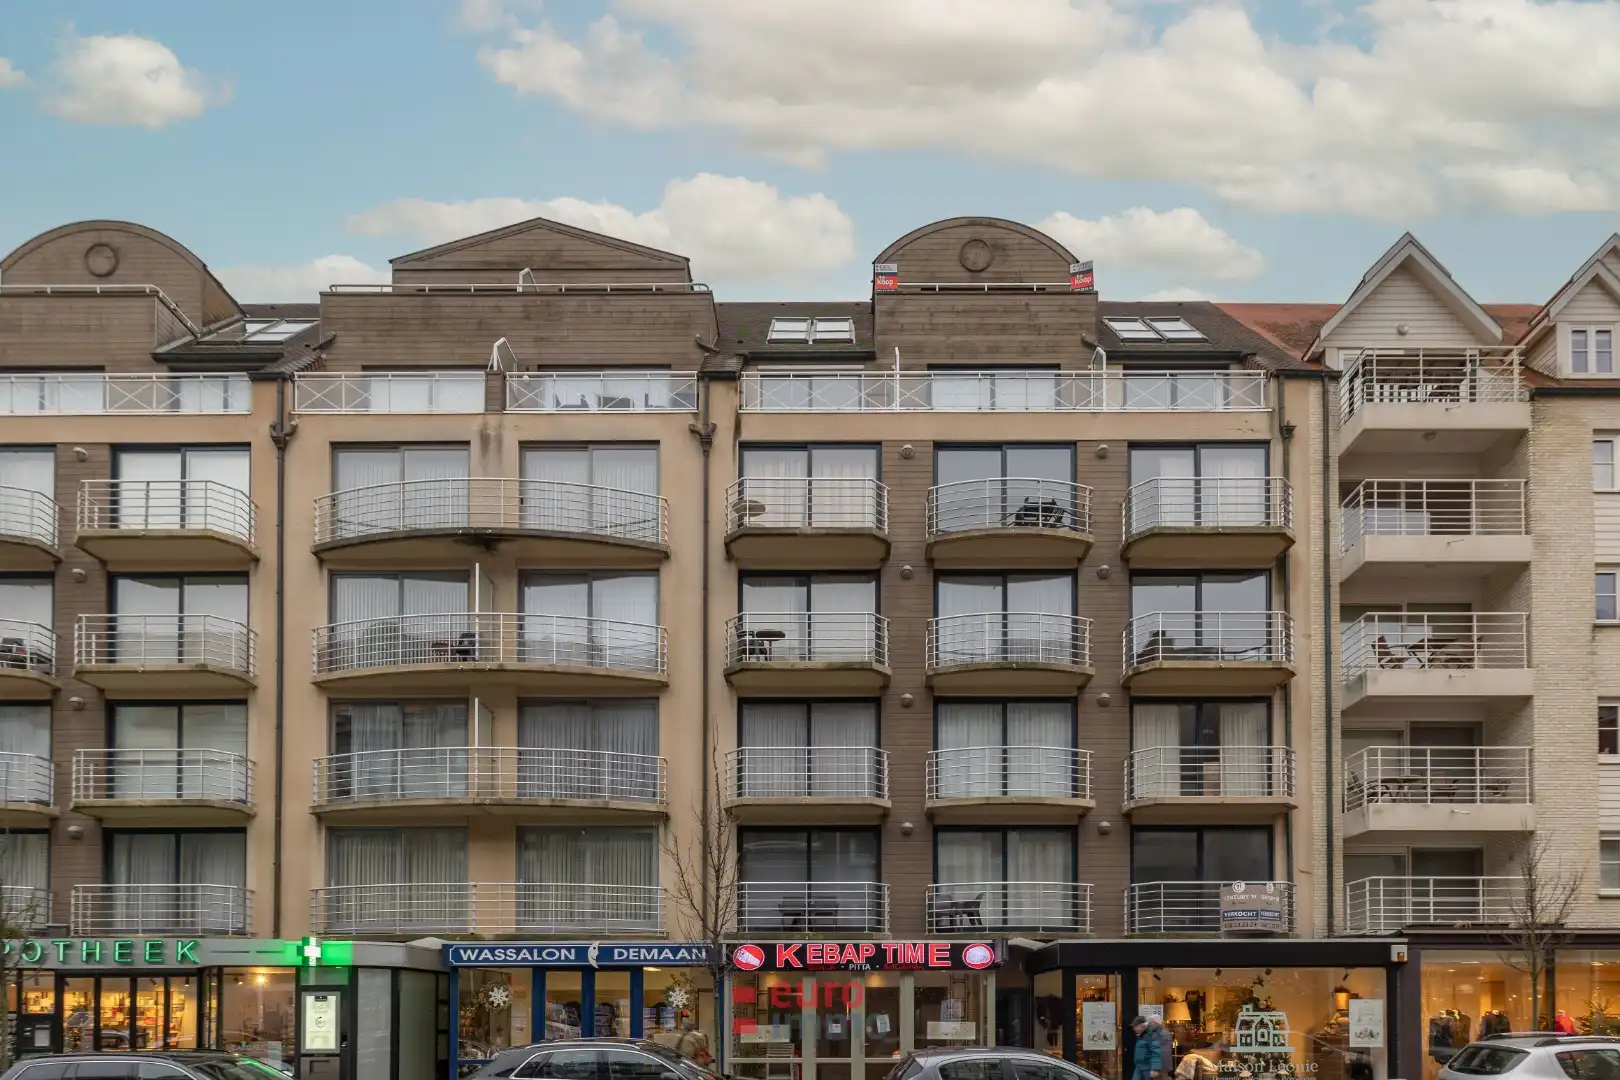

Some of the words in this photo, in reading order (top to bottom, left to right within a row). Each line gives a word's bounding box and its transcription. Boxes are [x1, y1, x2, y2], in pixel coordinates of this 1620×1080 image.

[876, 278, 894, 286] koop
[1074, 277, 1092, 285] koop
[459, 948, 576, 961] WASSALON
[613, 948, 707, 961] DEMAAN
[776, 943, 877, 968] KEBAP
[882, 943, 953, 967] TIME
[848, 963, 871, 971] PITTA
